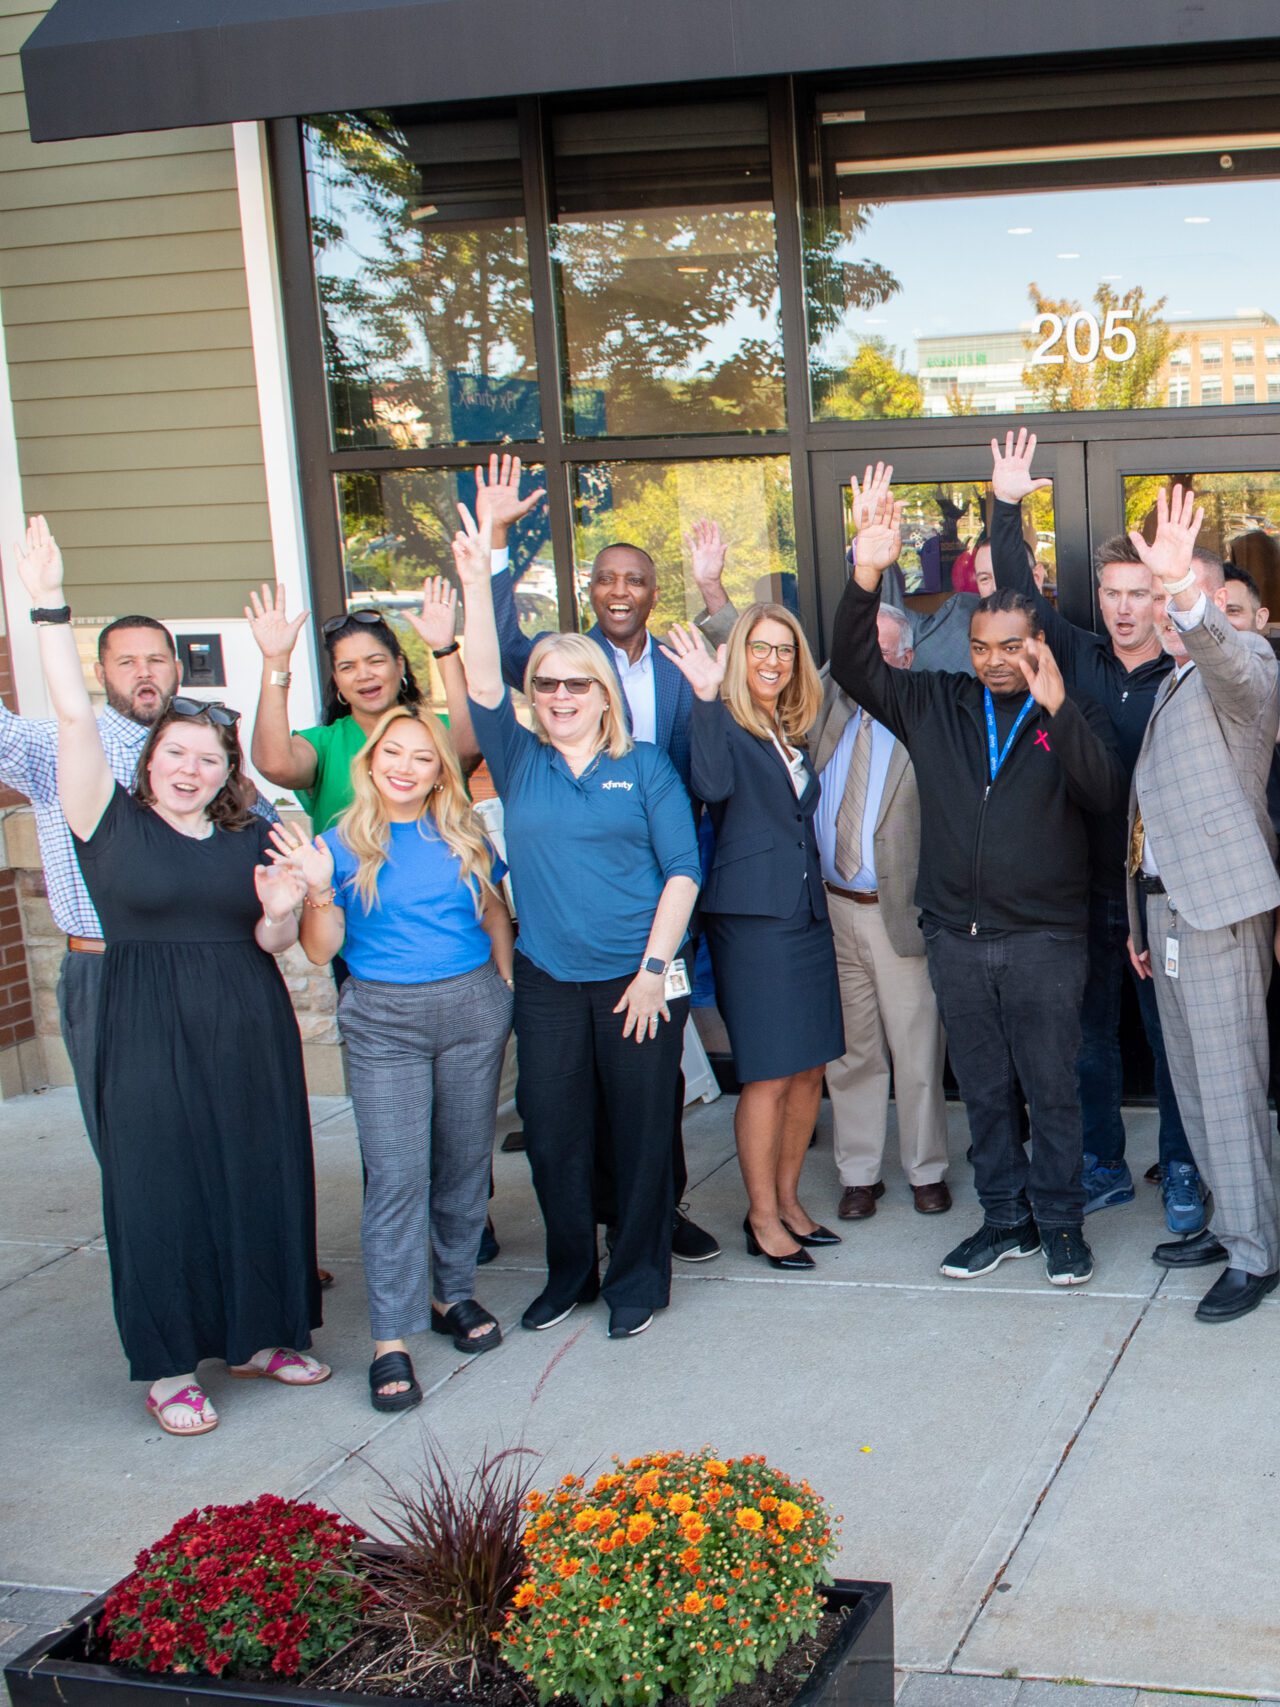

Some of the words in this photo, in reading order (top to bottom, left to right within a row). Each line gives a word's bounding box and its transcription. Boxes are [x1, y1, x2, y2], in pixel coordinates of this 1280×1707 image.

[1031, 310, 1137, 364] 205
[459, 389, 498, 412] xnity
[602, 780, 634, 791] xfinity
